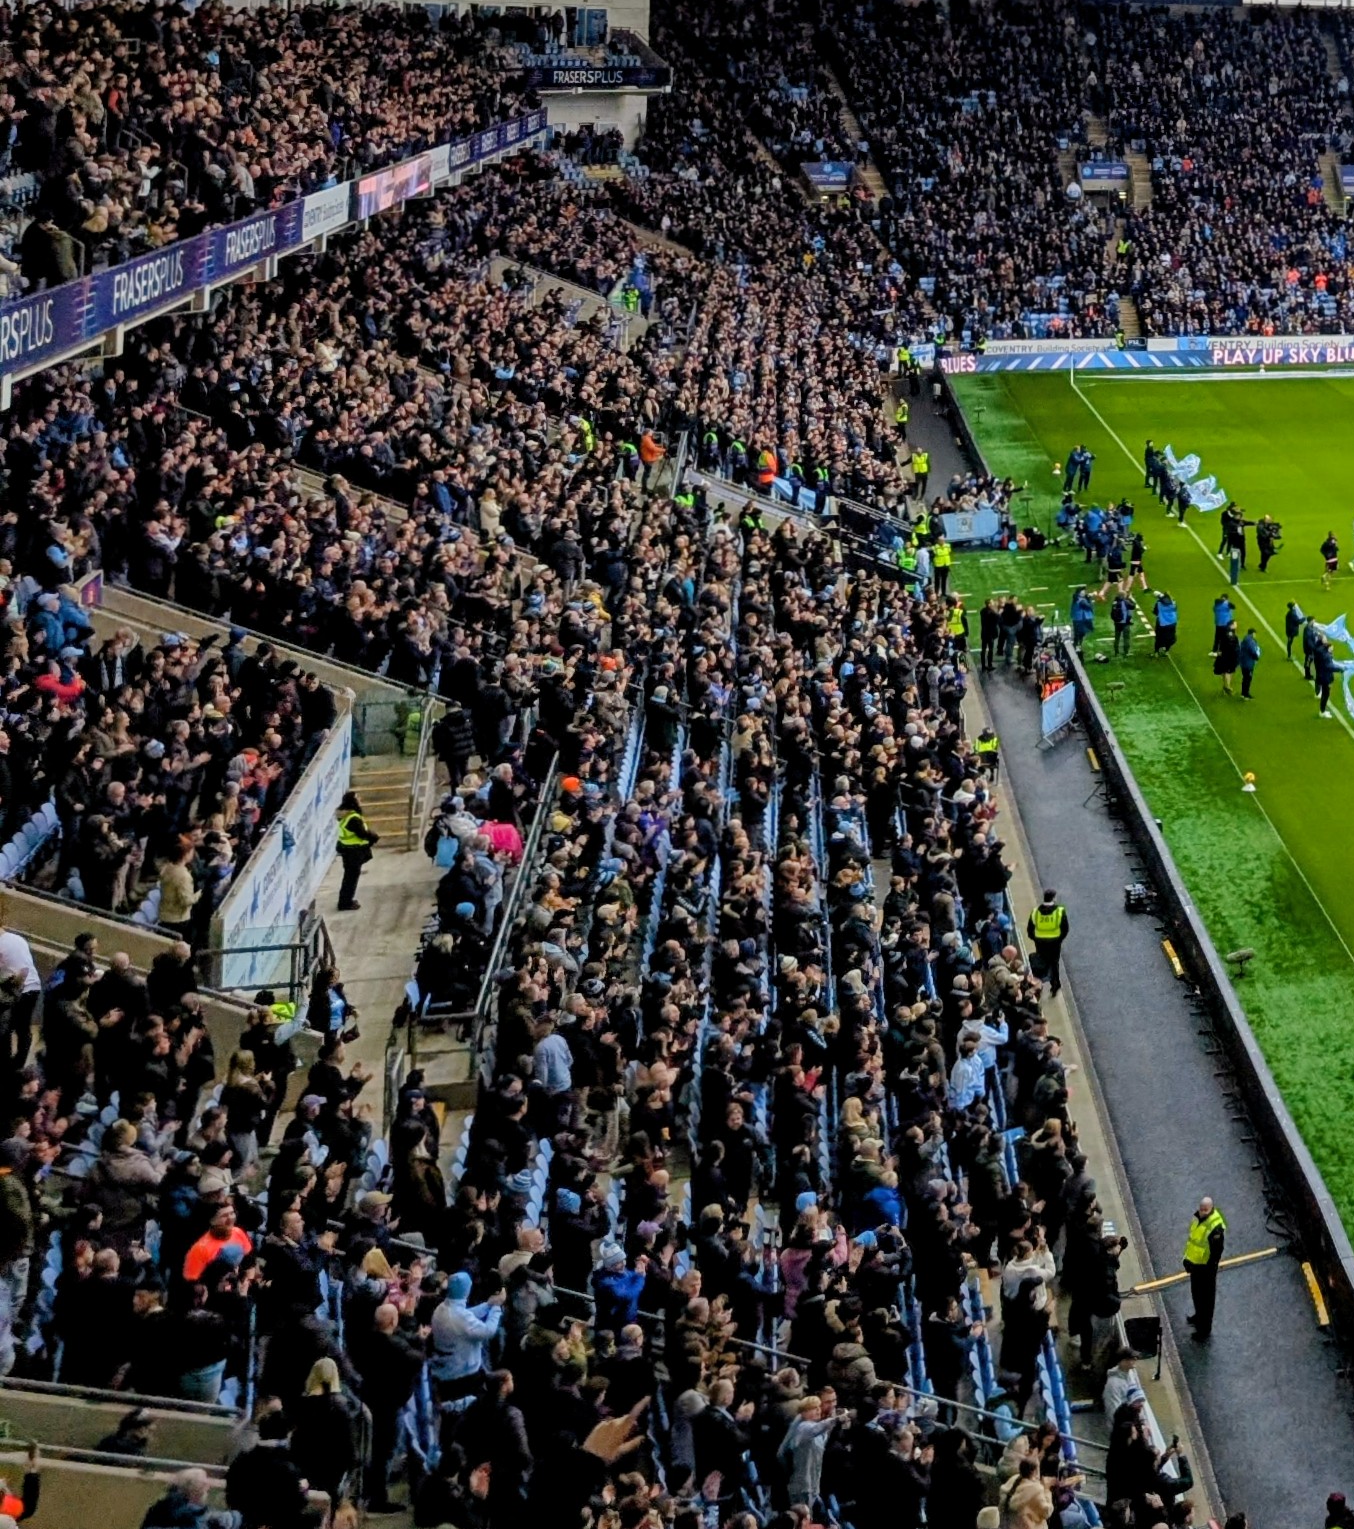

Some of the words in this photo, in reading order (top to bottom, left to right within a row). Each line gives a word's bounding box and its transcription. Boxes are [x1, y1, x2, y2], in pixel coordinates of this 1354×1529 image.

[553, 70, 623, 84] FRASERSPLUS
[225, 215, 276, 266] FRASERSPLUS
[113, 249, 184, 315] FRASERSPLUS
[987, 345, 1033, 354] COVENTRY
[1037, 343, 1069, 353] Building
[1213, 349, 1256, 365] PLAY
[1263, 348, 1284, 364] UP
[1289, 348, 1322, 364] SKY
